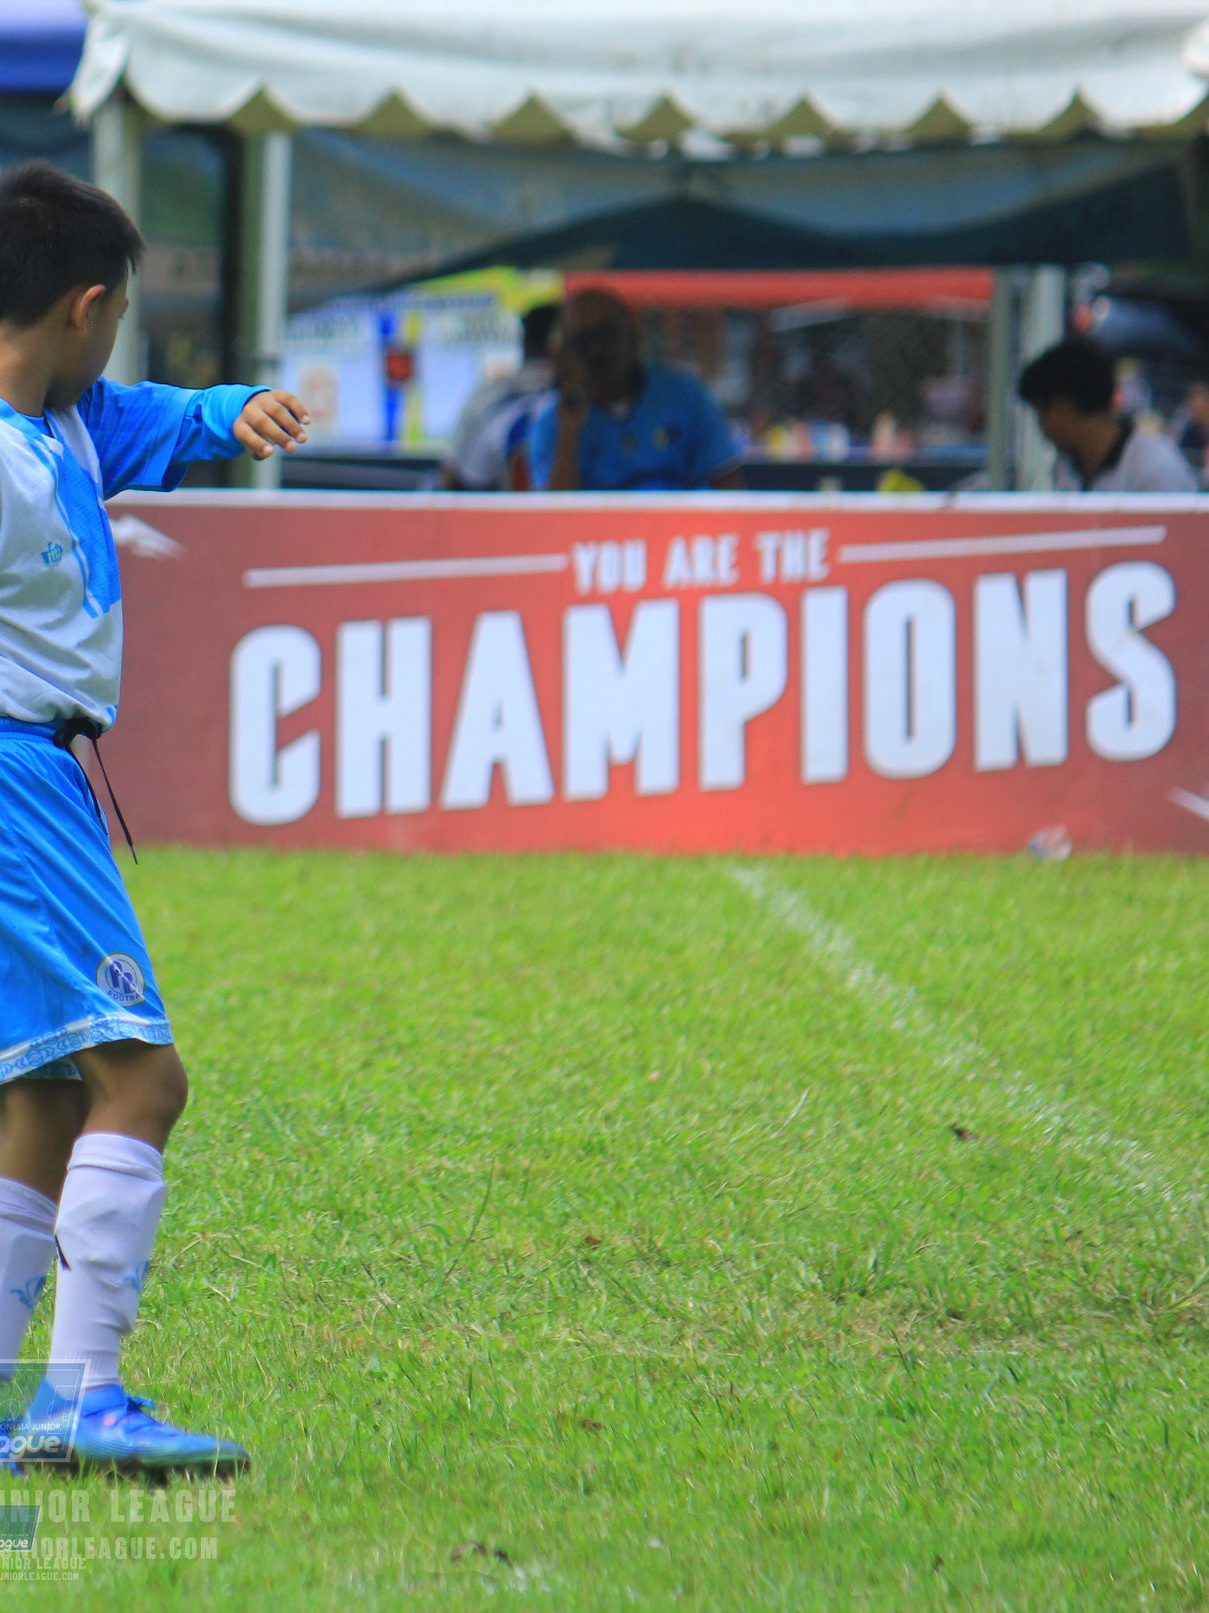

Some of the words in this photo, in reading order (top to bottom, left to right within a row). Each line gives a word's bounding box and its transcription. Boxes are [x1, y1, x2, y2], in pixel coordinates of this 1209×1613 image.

[571, 538, 648, 597] YOU
[661, 533, 741, 591] ARE
[753, 527, 831, 585] THE
[229, 561, 1178, 826] CHAMPIONS
